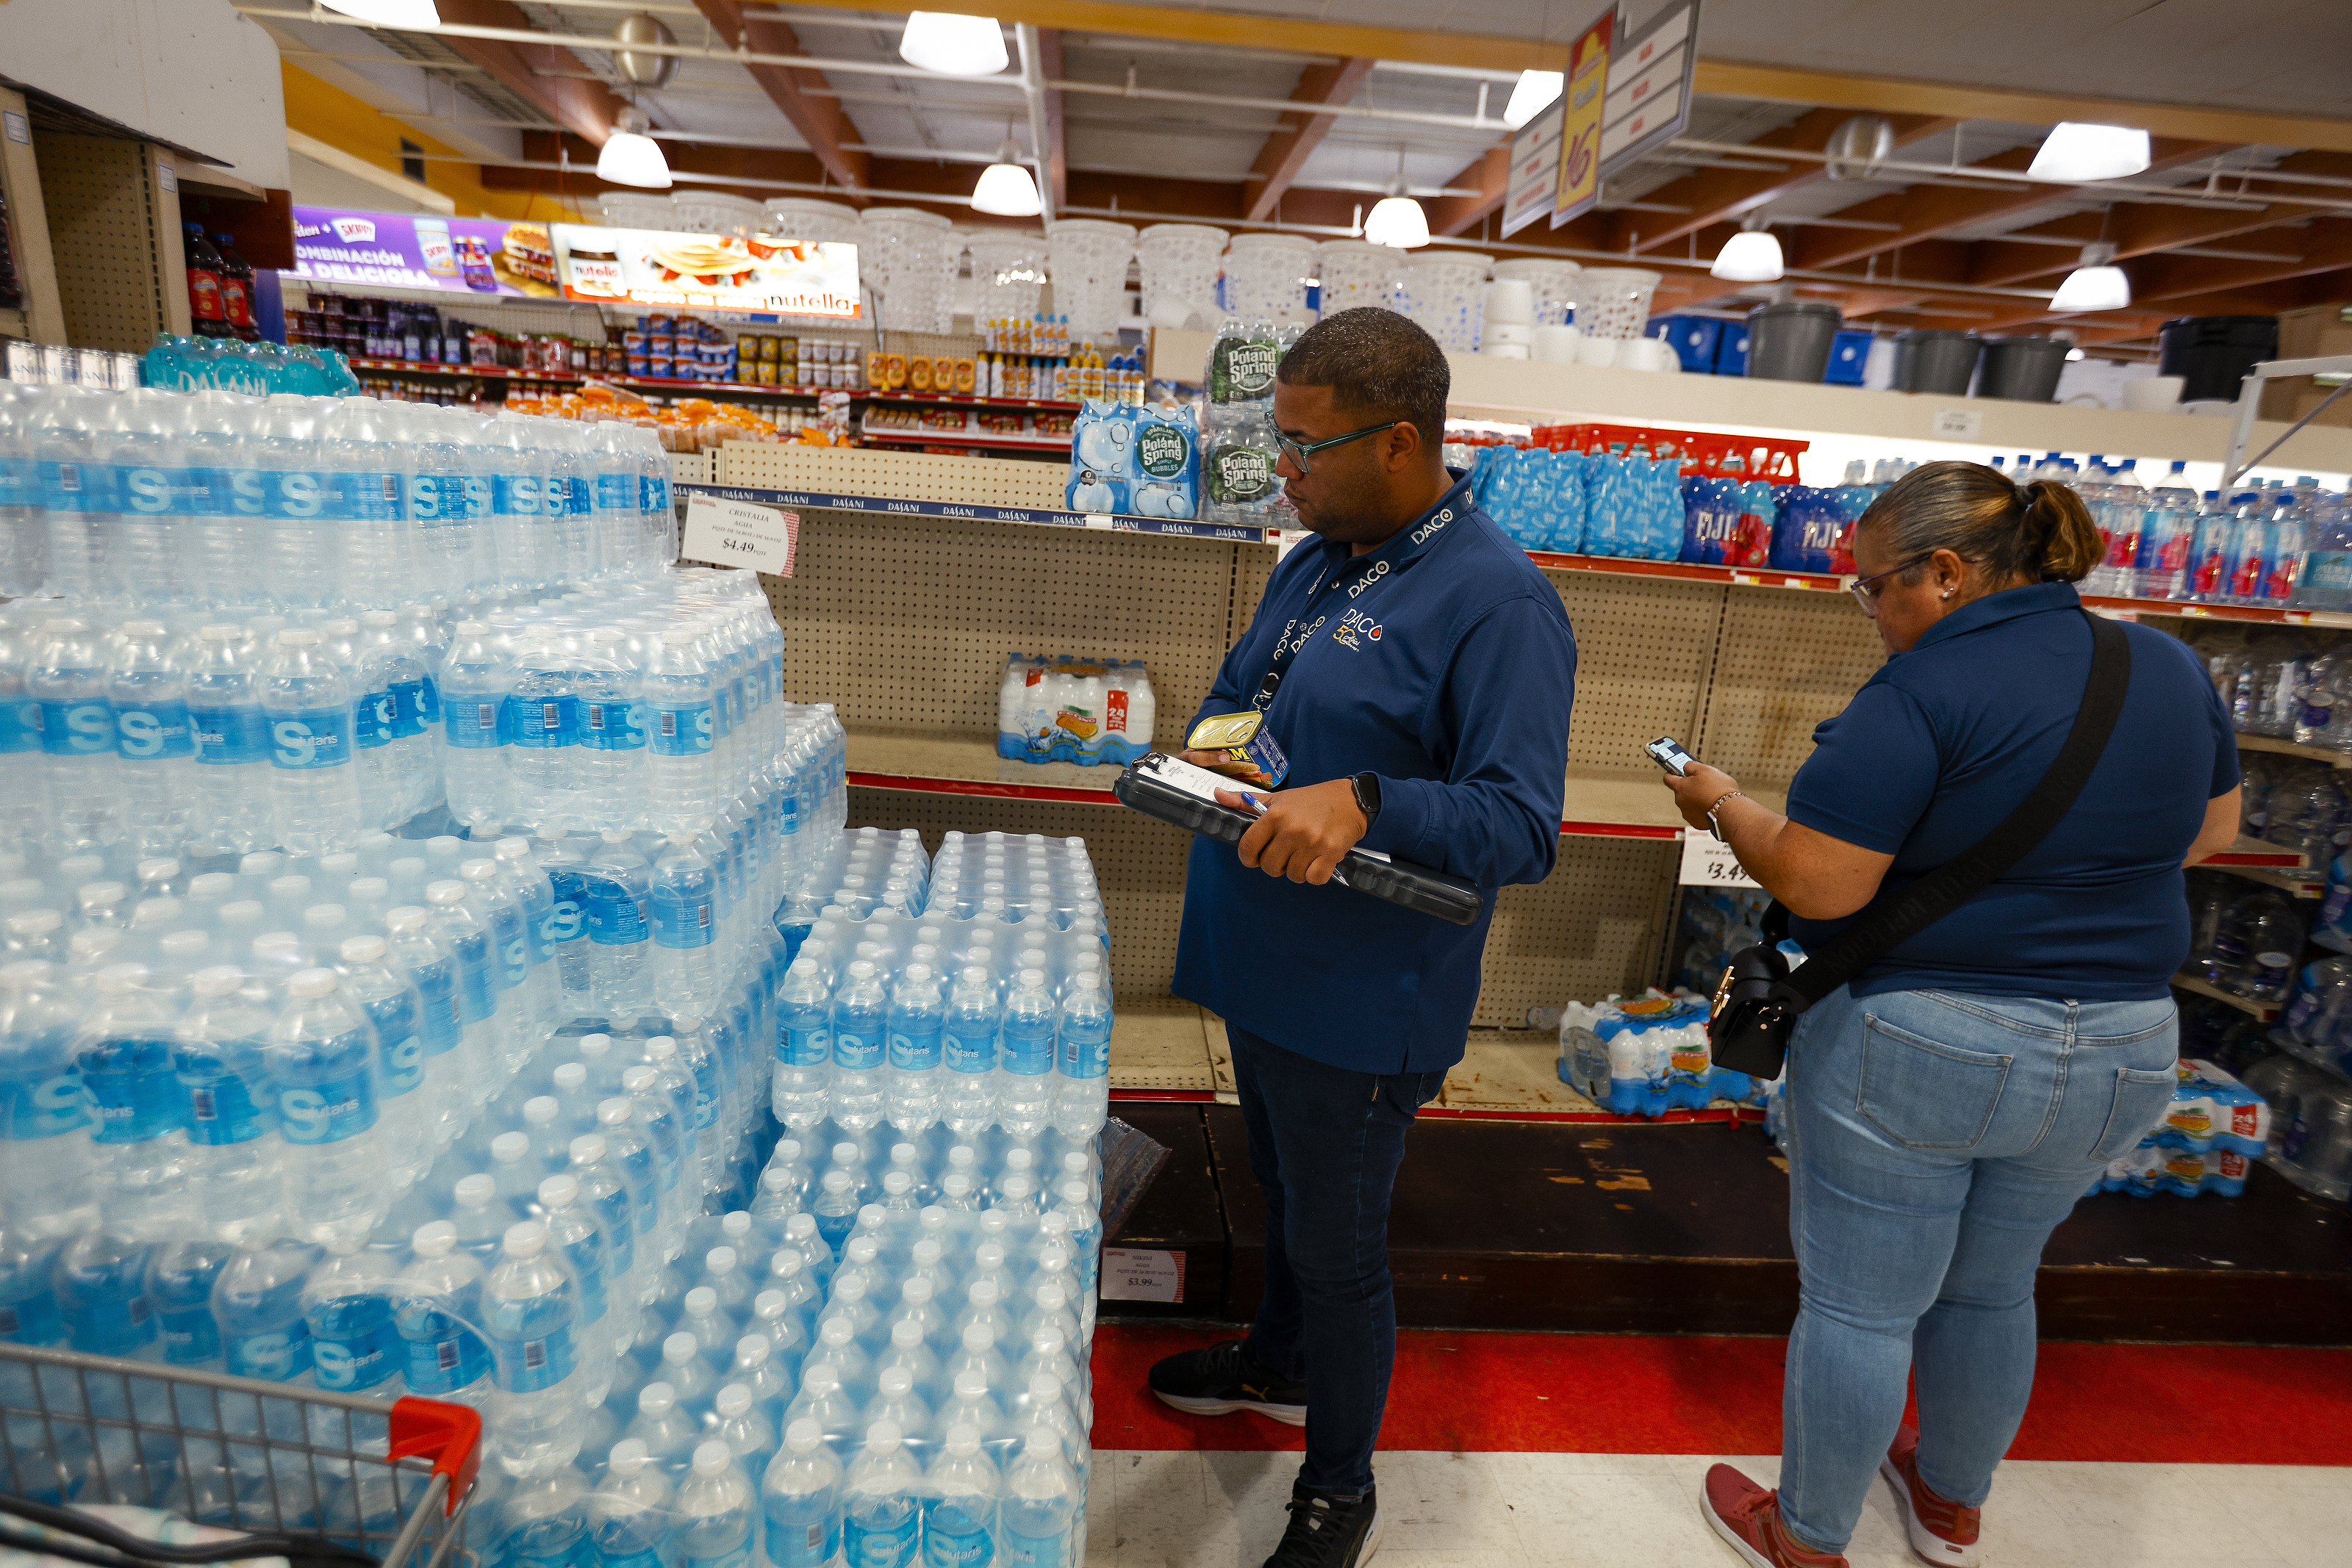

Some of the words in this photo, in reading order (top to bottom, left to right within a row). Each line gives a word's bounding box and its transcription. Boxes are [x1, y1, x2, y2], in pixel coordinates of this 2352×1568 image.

[296, 245, 406, 267] OMBINACIÓN
[770, 293, 850, 312] nutella
[1229, 347, 1277, 367] Poland
[1230, 362, 1277, 384] Spring
[1141, 436, 1182, 454] Poland
[1142, 447, 1183, 466] Spring
[1221, 454, 1267, 472] Poland
[1151, 464, 1179, 473] BUBBLES
[1222, 468, 1268, 488] Spring
[722, 489, 753, 501] DASANI
[777, 492, 809, 506] DASANI
[832, 497, 864, 510] DASANI
[887, 501, 919, 514] DASANI
[943, 506, 975, 518] DASANI
[998, 509, 1030, 522] DASANI
[1053, 514, 1084, 527] DASANI
[1113, 519, 1139, 531] ASANI
[1161, 522, 1193, 535] DASANI
[1216, 526, 1247, 539] DASANI
[1410, 508, 1454, 545] DACO
[1696, 511, 1733, 541] FIJI
[1802, 520, 1840, 550] FIJI
[723, 537, 755, 553] $4.49
[1348, 560, 1390, 599] DACO
[1290, 615, 1326, 654] DACO
[1340, 608, 1383, 641] DACO
[1108, 708, 1125, 718] 24
[274, 720, 317, 766] S
[1222, 747, 1251, 761] AM
[838, 1034, 864, 1067] S
[892, 1033, 914, 1067] S
[282, 1089, 331, 1140] S
[1128, 1277, 1152, 1287] $3.99
